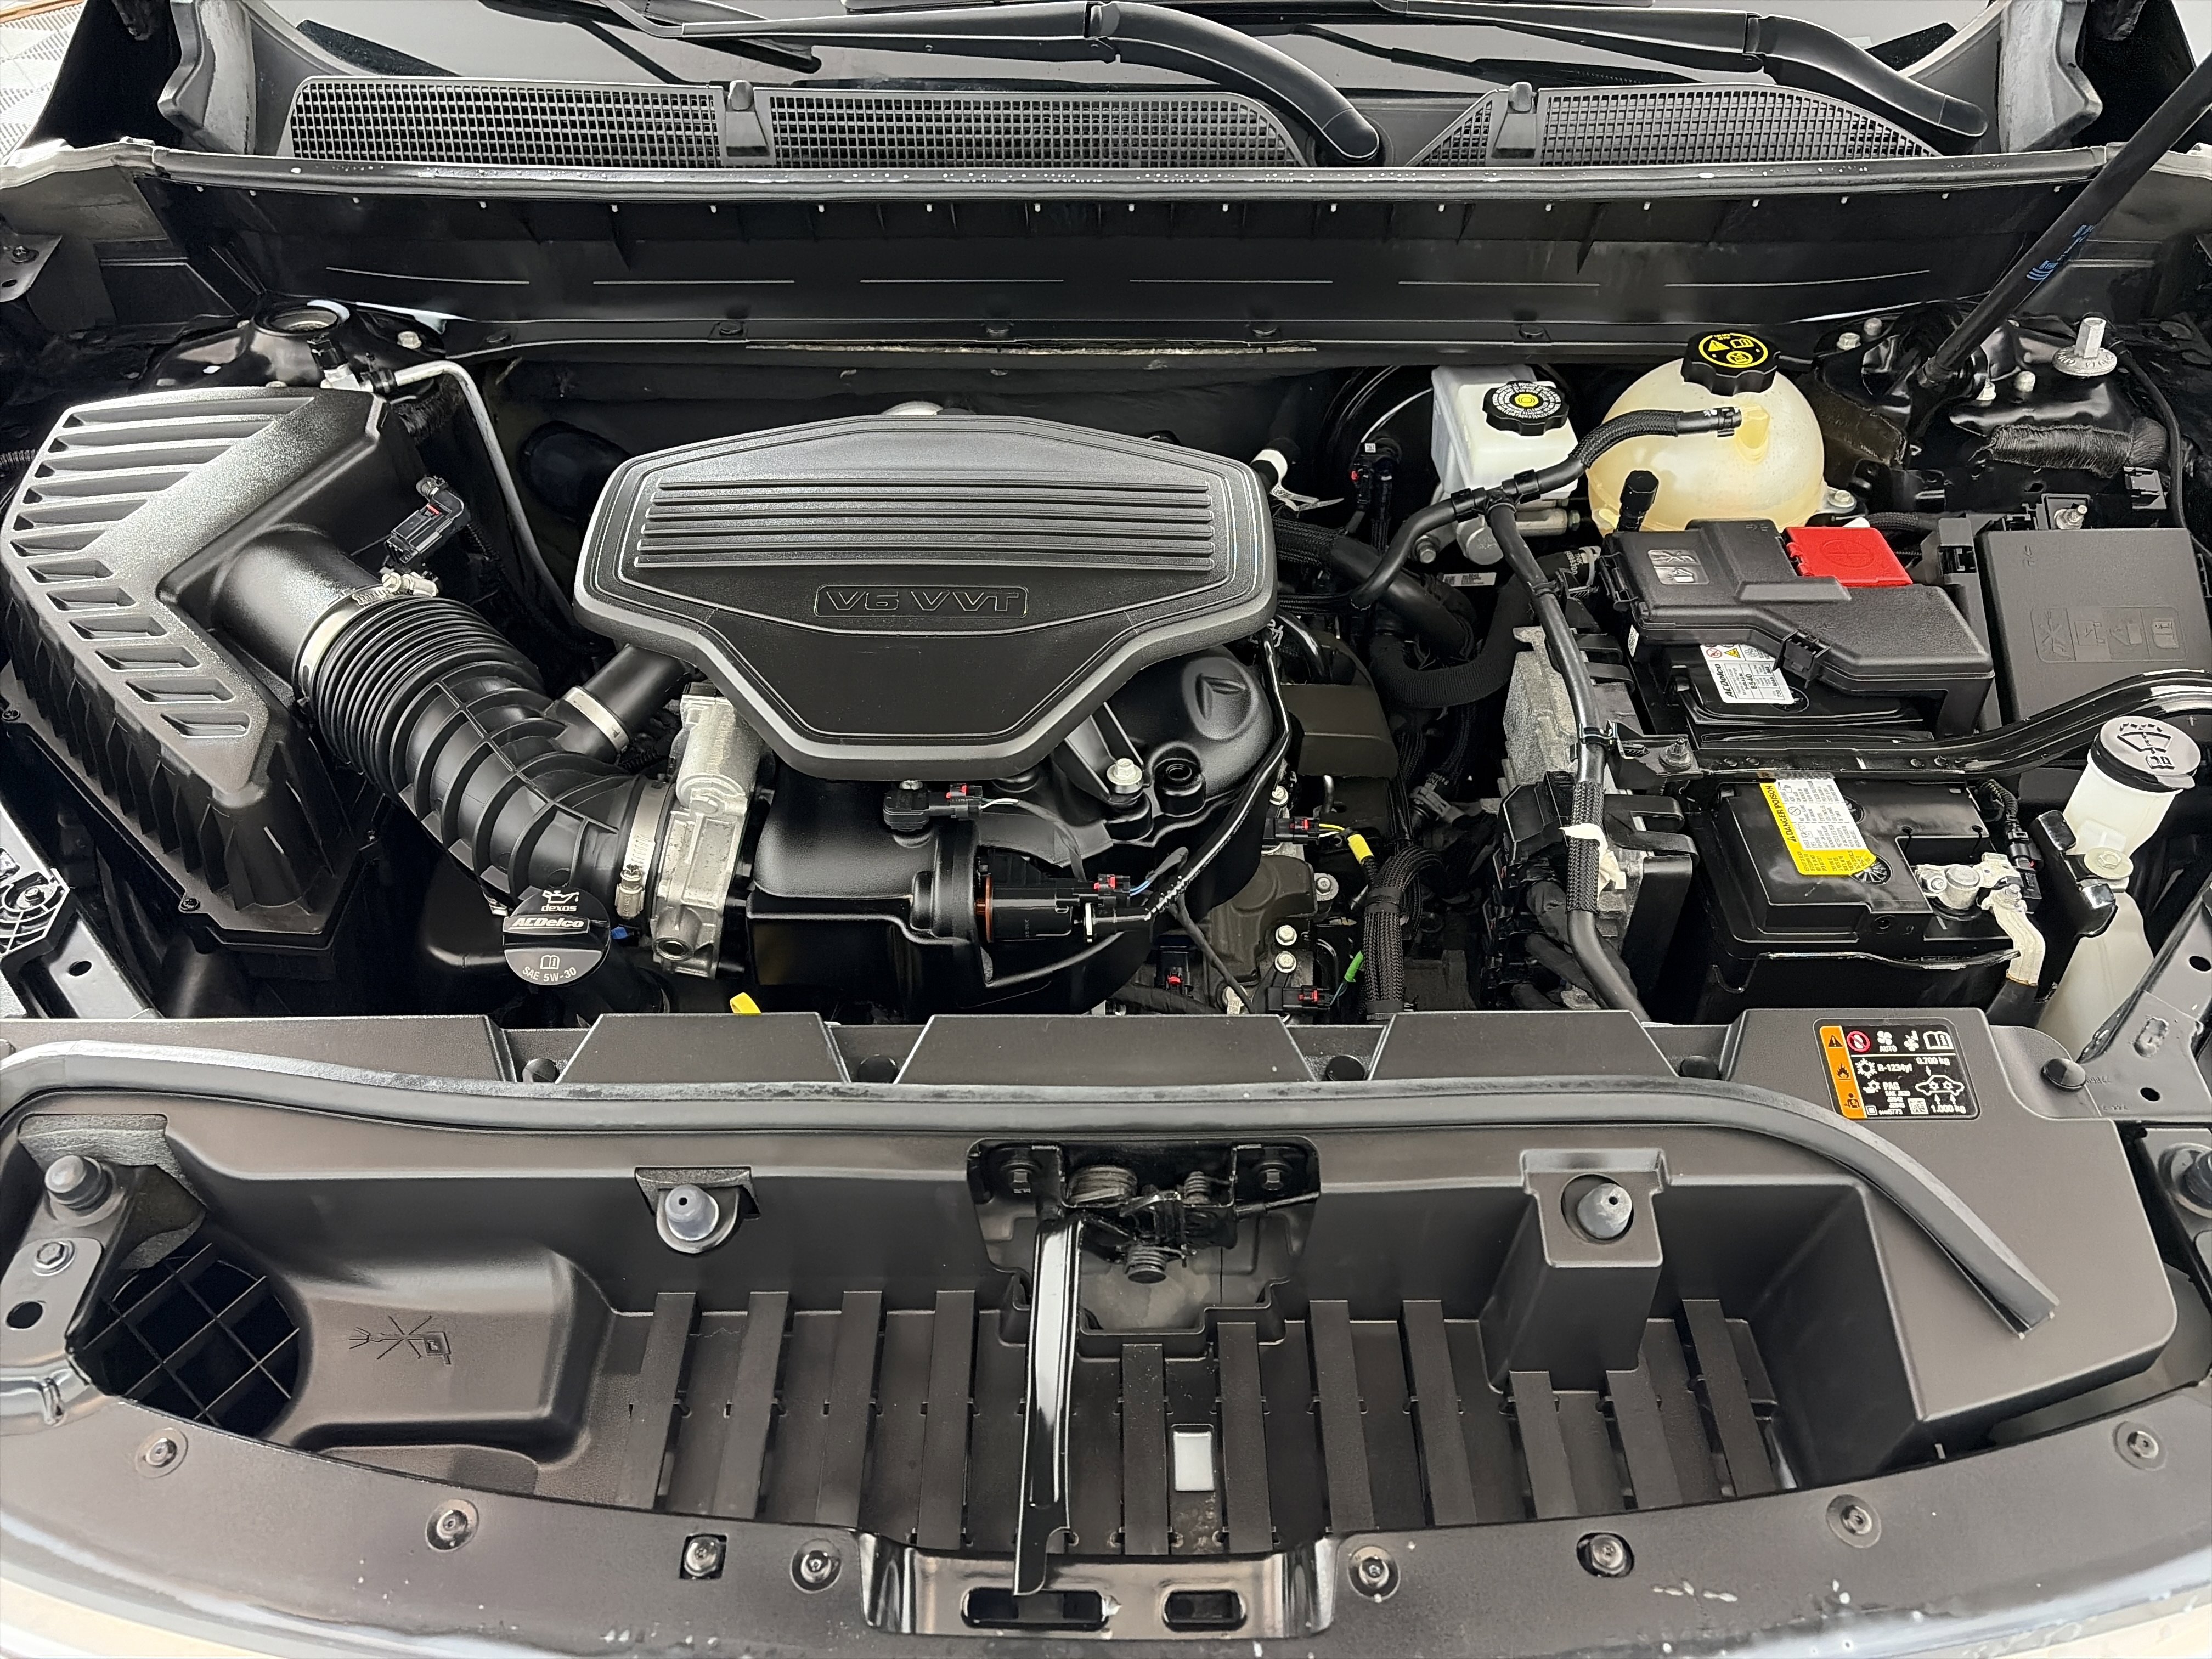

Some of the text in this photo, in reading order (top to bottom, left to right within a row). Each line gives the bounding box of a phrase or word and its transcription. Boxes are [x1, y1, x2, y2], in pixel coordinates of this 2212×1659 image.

[1574, 552, 1583, 566] TNK
[826, 591, 1019, 611] V6 VVT
[1714, 663, 1734, 697] ACDelco
[1745, 674, 1757, 689] 8540
[1768, 786, 1795, 837] DANGER/POISON
[511, 918, 584, 928] ACDelco
[522, 966, 577, 982] SAE 5W-30
[1877, 1063, 1912, 1073] R-1234yf
[1938, 1057, 1950, 1065] kg
[1882, 1082, 1900, 1091] PAG
[1931, 1104, 1966, 1114] 1.000 kg
